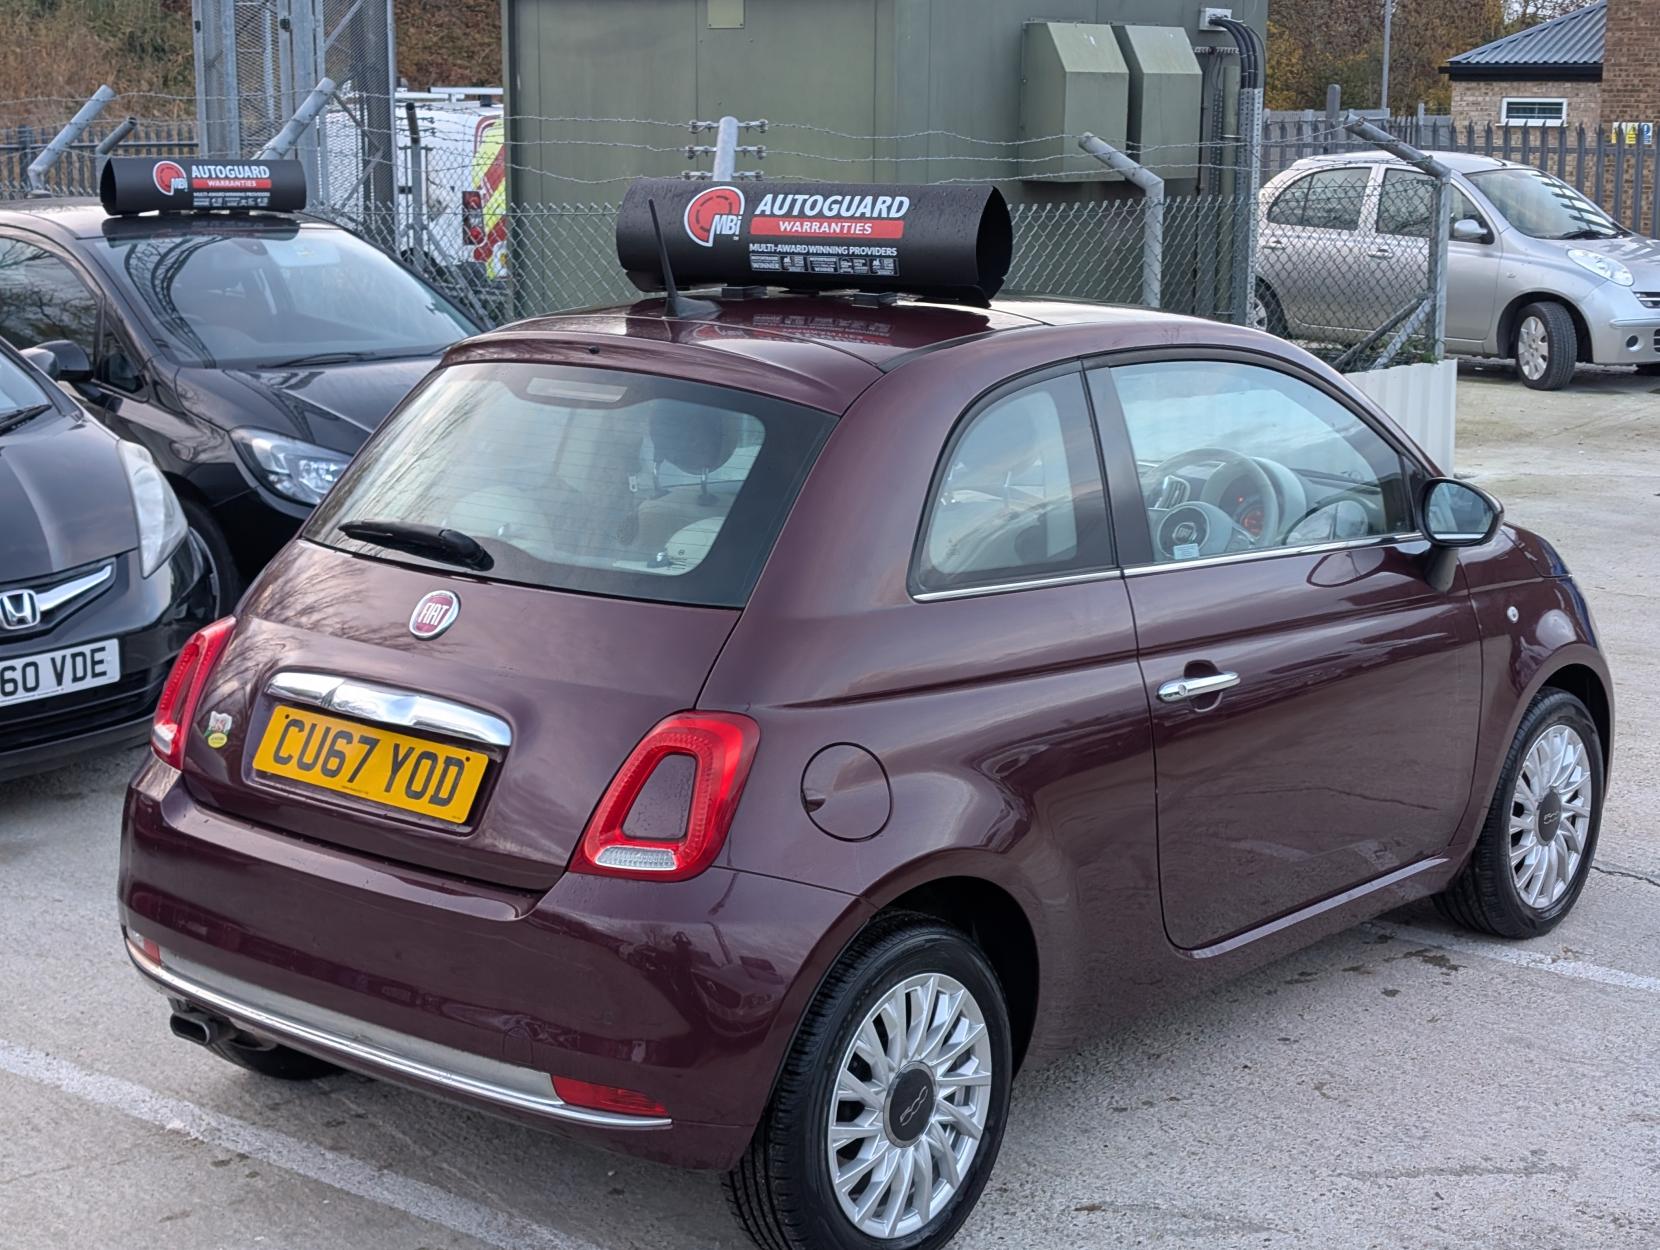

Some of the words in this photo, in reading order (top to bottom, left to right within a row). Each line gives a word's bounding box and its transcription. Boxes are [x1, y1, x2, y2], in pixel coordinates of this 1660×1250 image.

[191, 165, 270, 178] AUTOGUARD
[754, 193, 910, 218] AUTOGUARD
[713, 214, 742, 235] MBi
[779, 220, 873, 235] WARRANTIES
[749, 243, 808, 254] MULTI-AWARD
[808, 245, 848, 255] WINNING
[849, 246, 898, 256] PROVIDERS
[417, 602, 450, 626] FIAT
[50, 646, 108, 687] VDE
[273, 718, 381, 784] CU67
[384, 743, 466, 808] YOD
